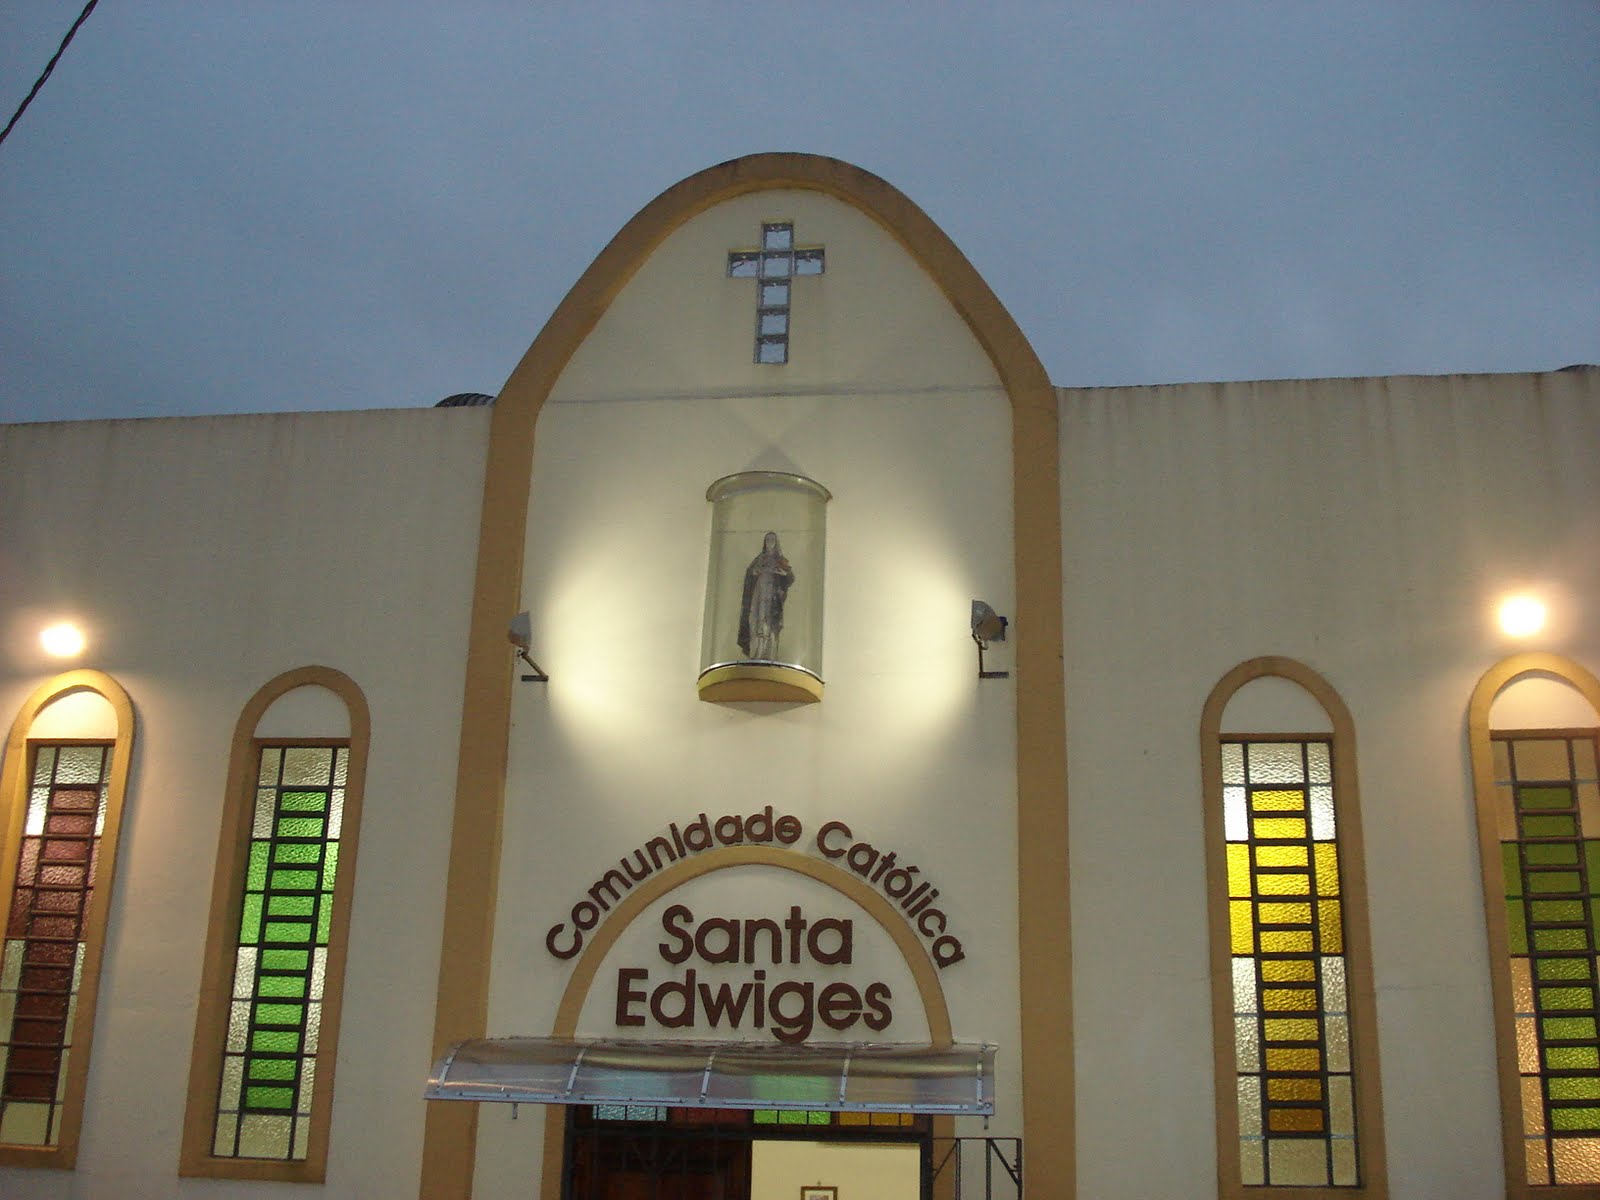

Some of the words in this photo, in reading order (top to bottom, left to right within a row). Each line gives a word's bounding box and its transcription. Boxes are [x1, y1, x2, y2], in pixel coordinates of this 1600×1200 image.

[546, 806, 802, 960] Comunidade
[816, 821, 965, 969] Católica
[659, 904, 853, 966] Santa
[615, 968, 893, 1043] Edwiges
